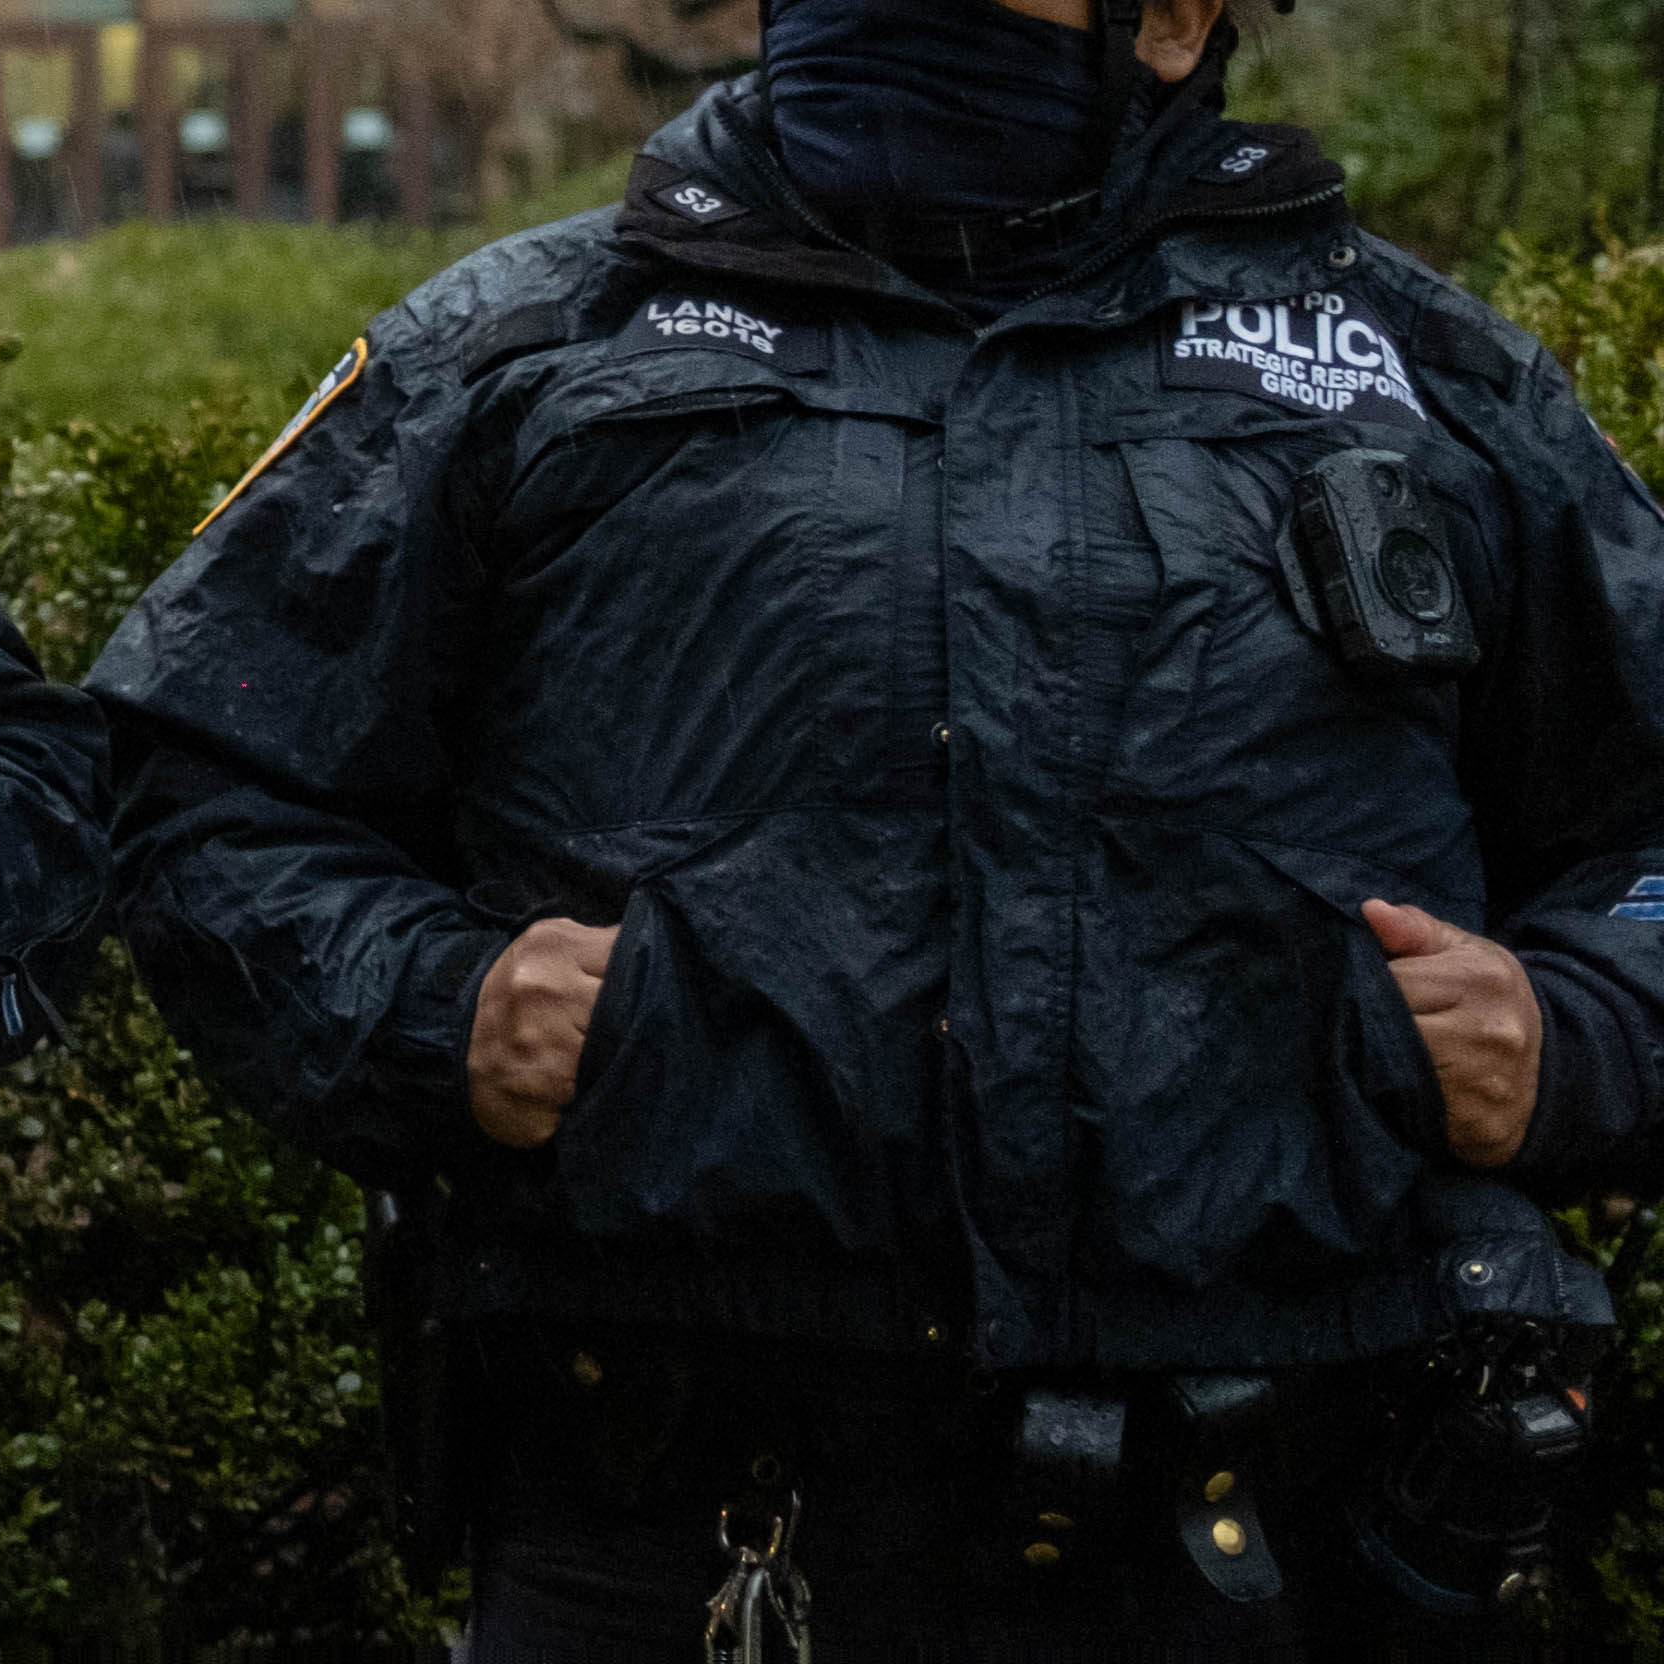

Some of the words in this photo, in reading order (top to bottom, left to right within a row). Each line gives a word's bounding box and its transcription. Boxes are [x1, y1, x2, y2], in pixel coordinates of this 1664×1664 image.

[1219, 146, 1269, 173] S3
[674, 187, 722, 213] S3
[647, 300, 783, 339] LANDY
[1174, 338, 1306, 380] STRATEGIC
[1181, 302, 1415, 394] POLICE
[1260, 373, 1355, 413] GROUP
